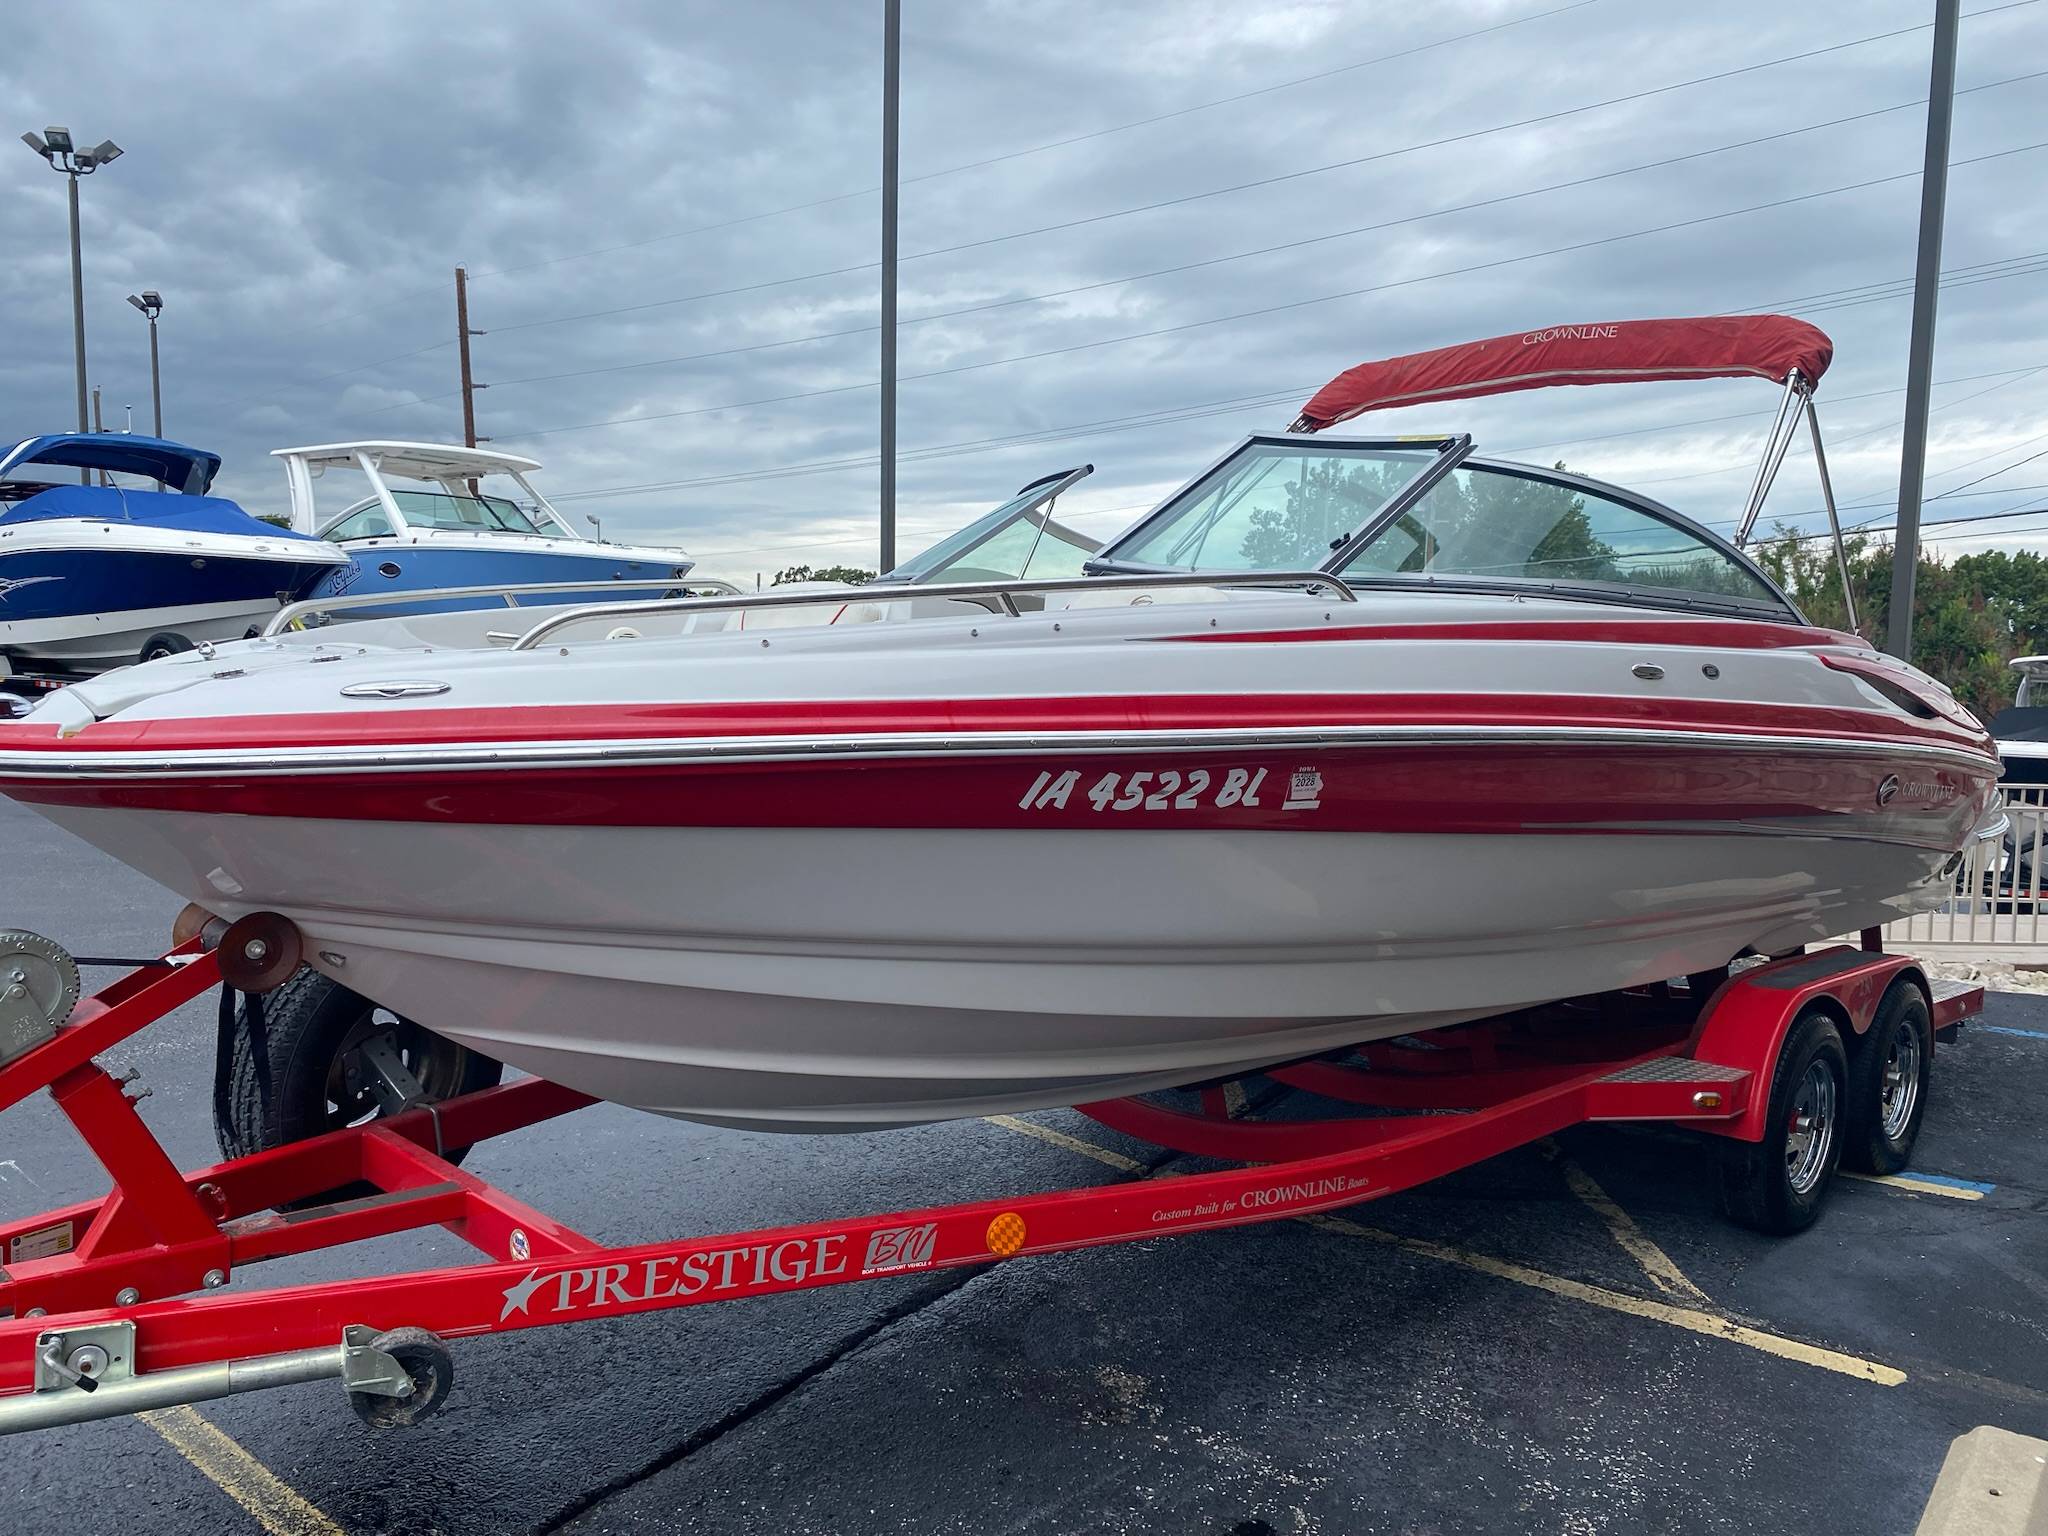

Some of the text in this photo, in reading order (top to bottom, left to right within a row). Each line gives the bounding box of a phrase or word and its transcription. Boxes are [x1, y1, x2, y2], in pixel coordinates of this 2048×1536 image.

[1522, 325, 1619, 345] CROWNLINE
[1018, 767, 1268, 811] IA 4522 BL
[1902, 782, 1955, 800] CROWNLINE
[1152, 1176, 1369, 1222] Custom Built for CROWNLINE Boats
[551, 1234, 847, 1312] PRESTIGE
[877, 1264, 906, 1272] TRANSPORT
